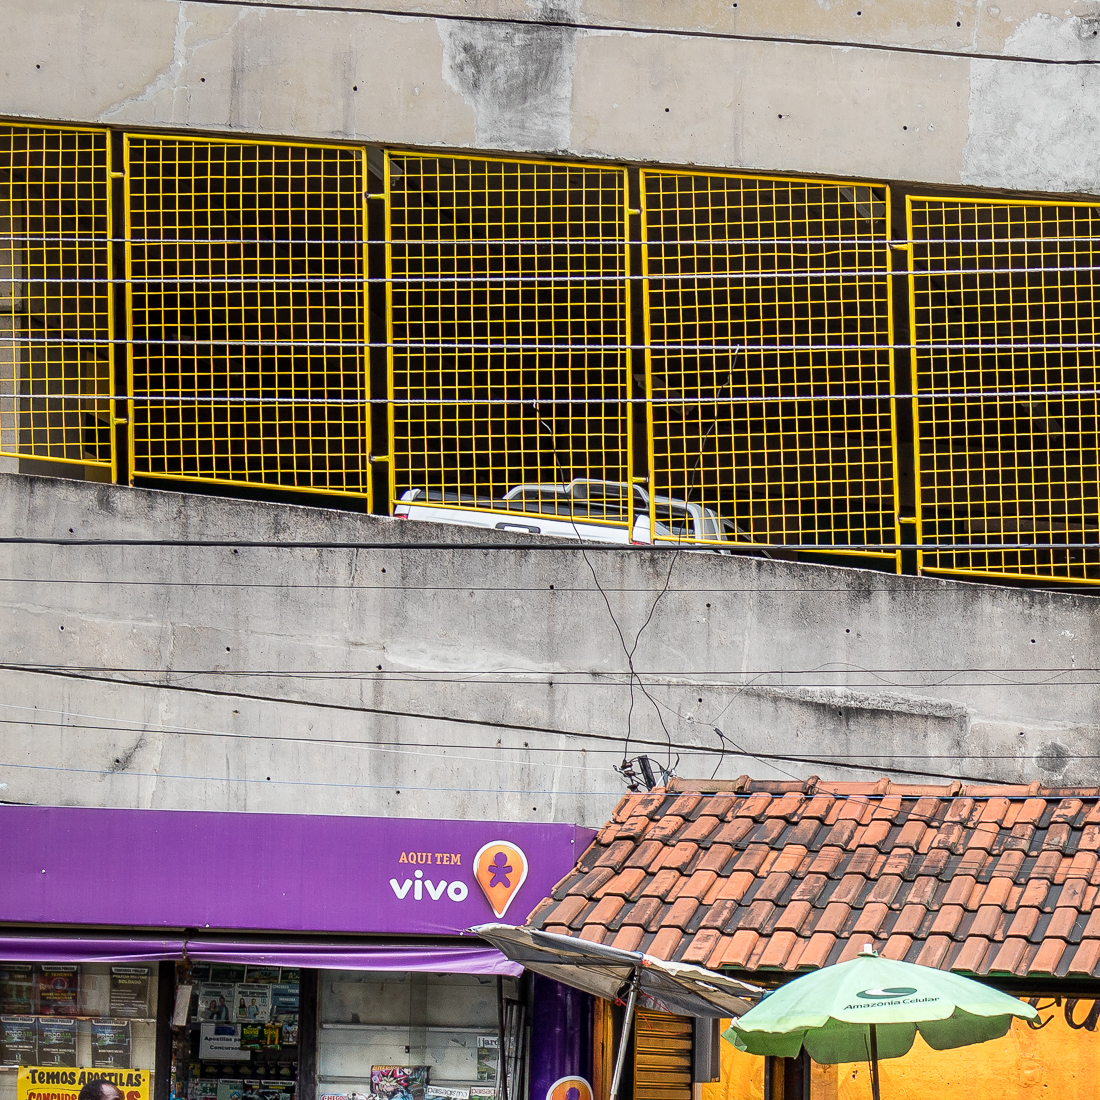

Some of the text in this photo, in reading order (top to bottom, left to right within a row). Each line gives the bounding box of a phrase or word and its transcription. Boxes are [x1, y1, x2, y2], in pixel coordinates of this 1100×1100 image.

[398, 851, 462, 866] AQUI TEM
[389, 869, 469, 902] vivo
[843, 996, 940, 1011] Amazônia Celular
[204, 1035, 233, 1043] Apostilas
